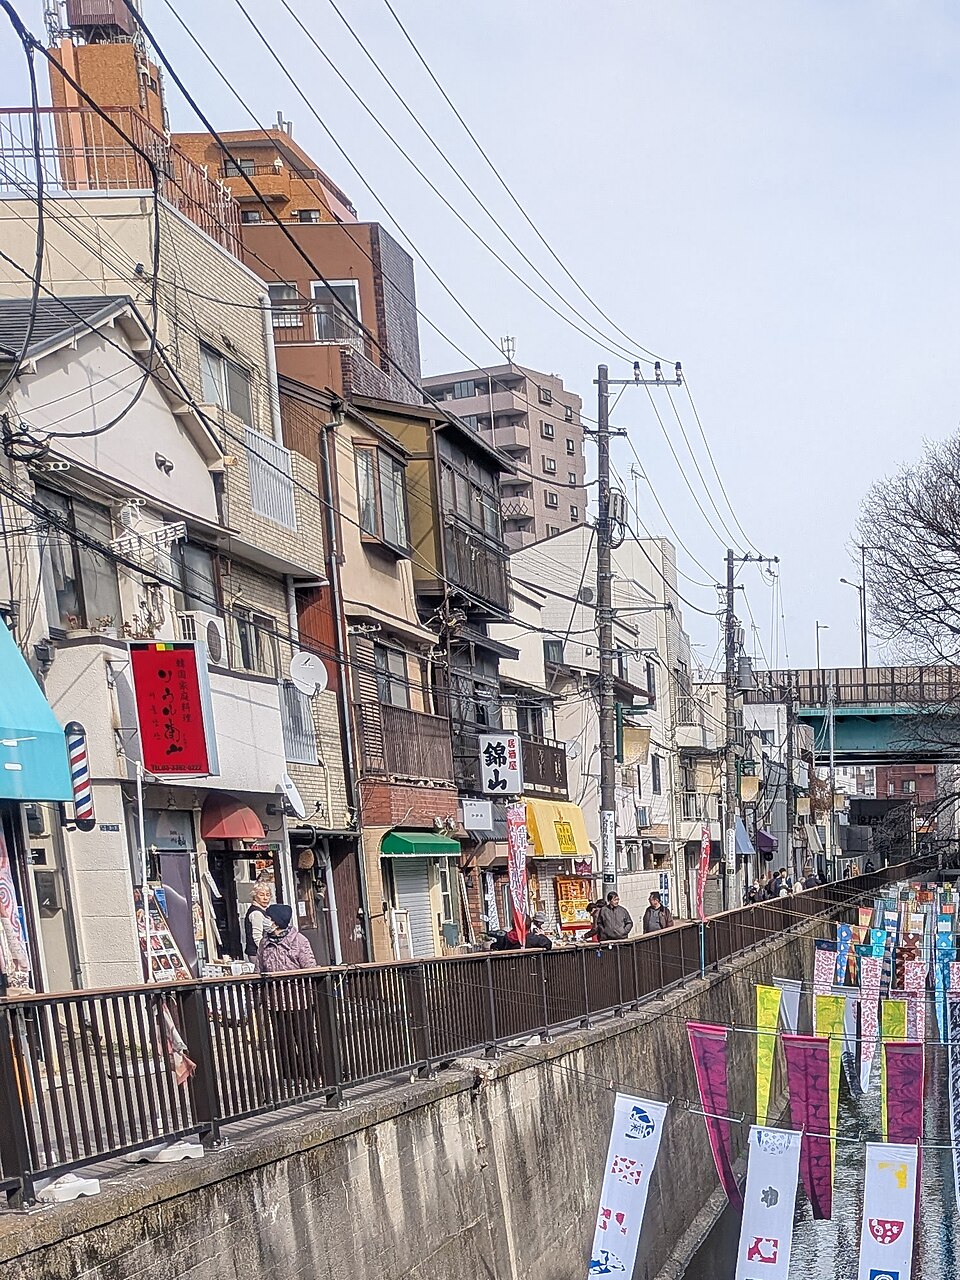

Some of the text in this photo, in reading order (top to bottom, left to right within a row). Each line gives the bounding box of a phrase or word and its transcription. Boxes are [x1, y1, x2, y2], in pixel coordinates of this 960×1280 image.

[483, 741, 508, 791] 錦山
[507, 738, 518, 771] 居酒屋
